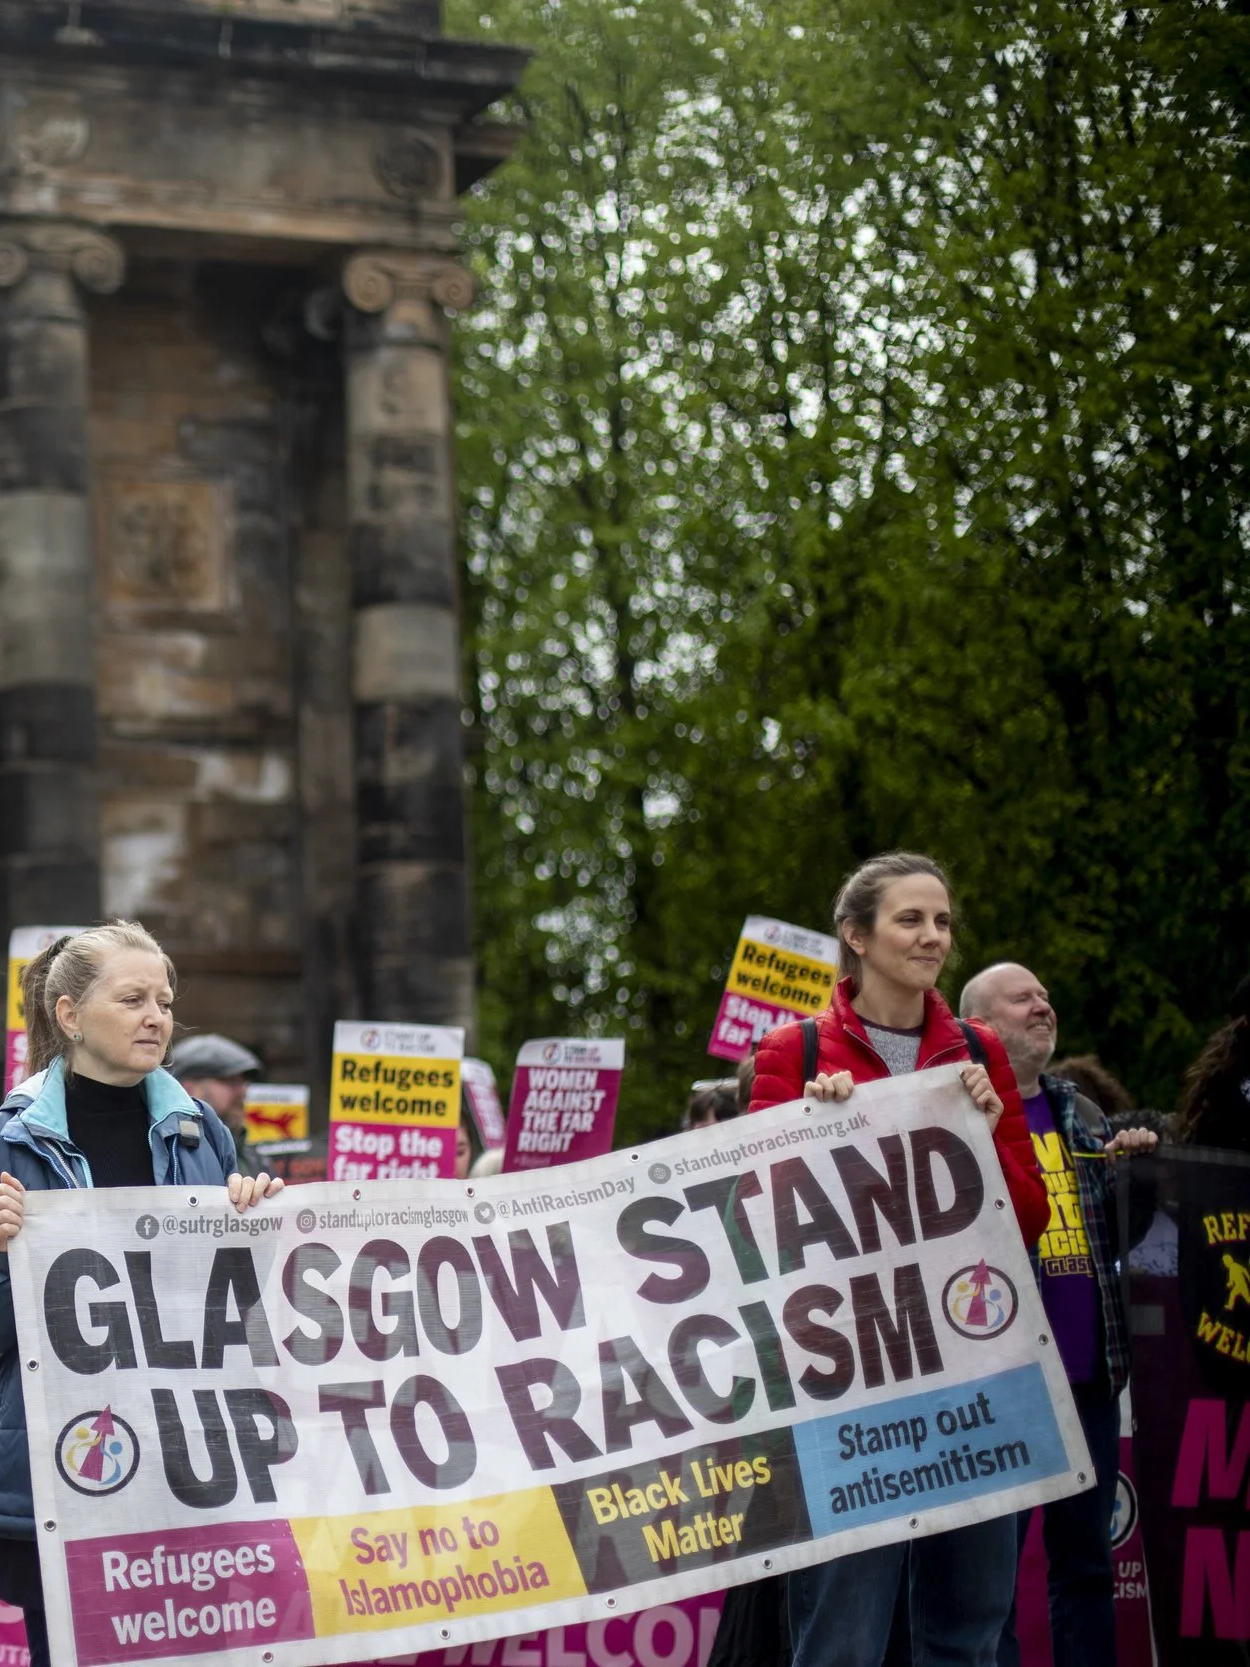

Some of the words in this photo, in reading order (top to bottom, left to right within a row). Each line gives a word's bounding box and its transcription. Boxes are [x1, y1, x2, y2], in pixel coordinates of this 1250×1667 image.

[742, 943, 832, 988] Refugees
[736, 969, 823, 1009] welcome
[717, 1016, 750, 1046] far
[341, 1059, 454, 1091] Refugees
[527, 1068, 599, 1092] WOMEN
[339, 1091, 447, 1116] welcome
[521, 1111, 560, 1133] THE
[560, 1112, 595, 1133] FAR
[523, 1089, 606, 1113] AGAINST
[335, 1124, 395, 1160] Stop
[400, 1129, 443, 1158] the
[516, 1132, 575, 1153] RIGHT
[163, 1214, 283, 1237] @sutrglasgow
[497, 1174, 636, 1218] @AntiRacismDay
[673, 1111, 871, 1177] standuptoracism.org.uk
[333, 1155, 373, 1180] far
[377, 1158, 440, 1180] right
[43, 1219, 587, 1376] GLASGOW
[616, 1126, 984, 1304] STAND
[150, 1387, 299, 1510] UP
[318, 1374, 478, 1496] TO
[494, 1262, 945, 1472] RACISM
[838, 1415, 928, 1461] Stamp
[936, 1391, 997, 1437] out
[586, 1471, 690, 1526] Black
[690, 1455, 773, 1498] Lives
[829, 1439, 1032, 1515] antisemitism
[350, 1526, 408, 1570] Say
[418, 1526, 459, 1557] no
[462, 1515, 500, 1550] to
[642, 1511, 746, 1563] Matter
[102, 1543, 276, 1593] Refugees
[339, 1555, 551, 1617] Islamophobia
[1118, 1561, 1142, 1578] UP
[111, 1597, 277, 1646] welcome
